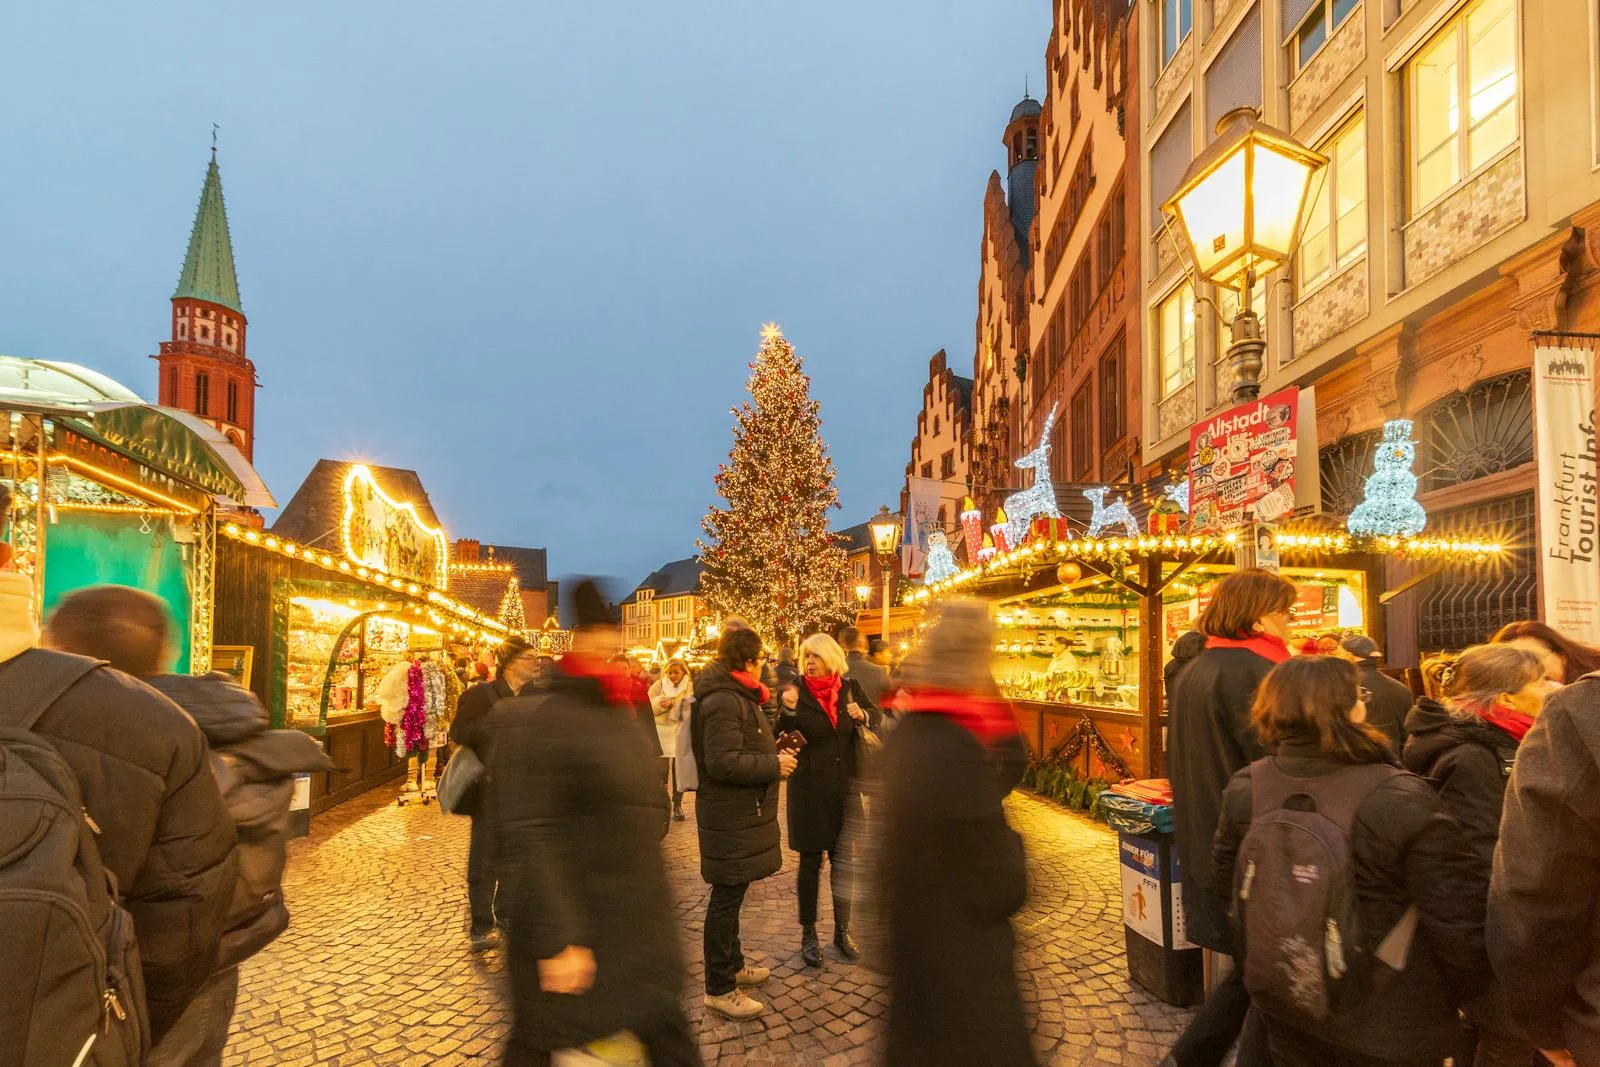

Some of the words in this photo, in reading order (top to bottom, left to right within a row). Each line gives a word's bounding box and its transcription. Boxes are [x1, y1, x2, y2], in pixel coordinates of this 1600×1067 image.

[1207, 402, 1269, 439] Altstadt
[1549, 452, 1576, 561] Frankfurt
[1570, 471, 1598, 564] Tourist
